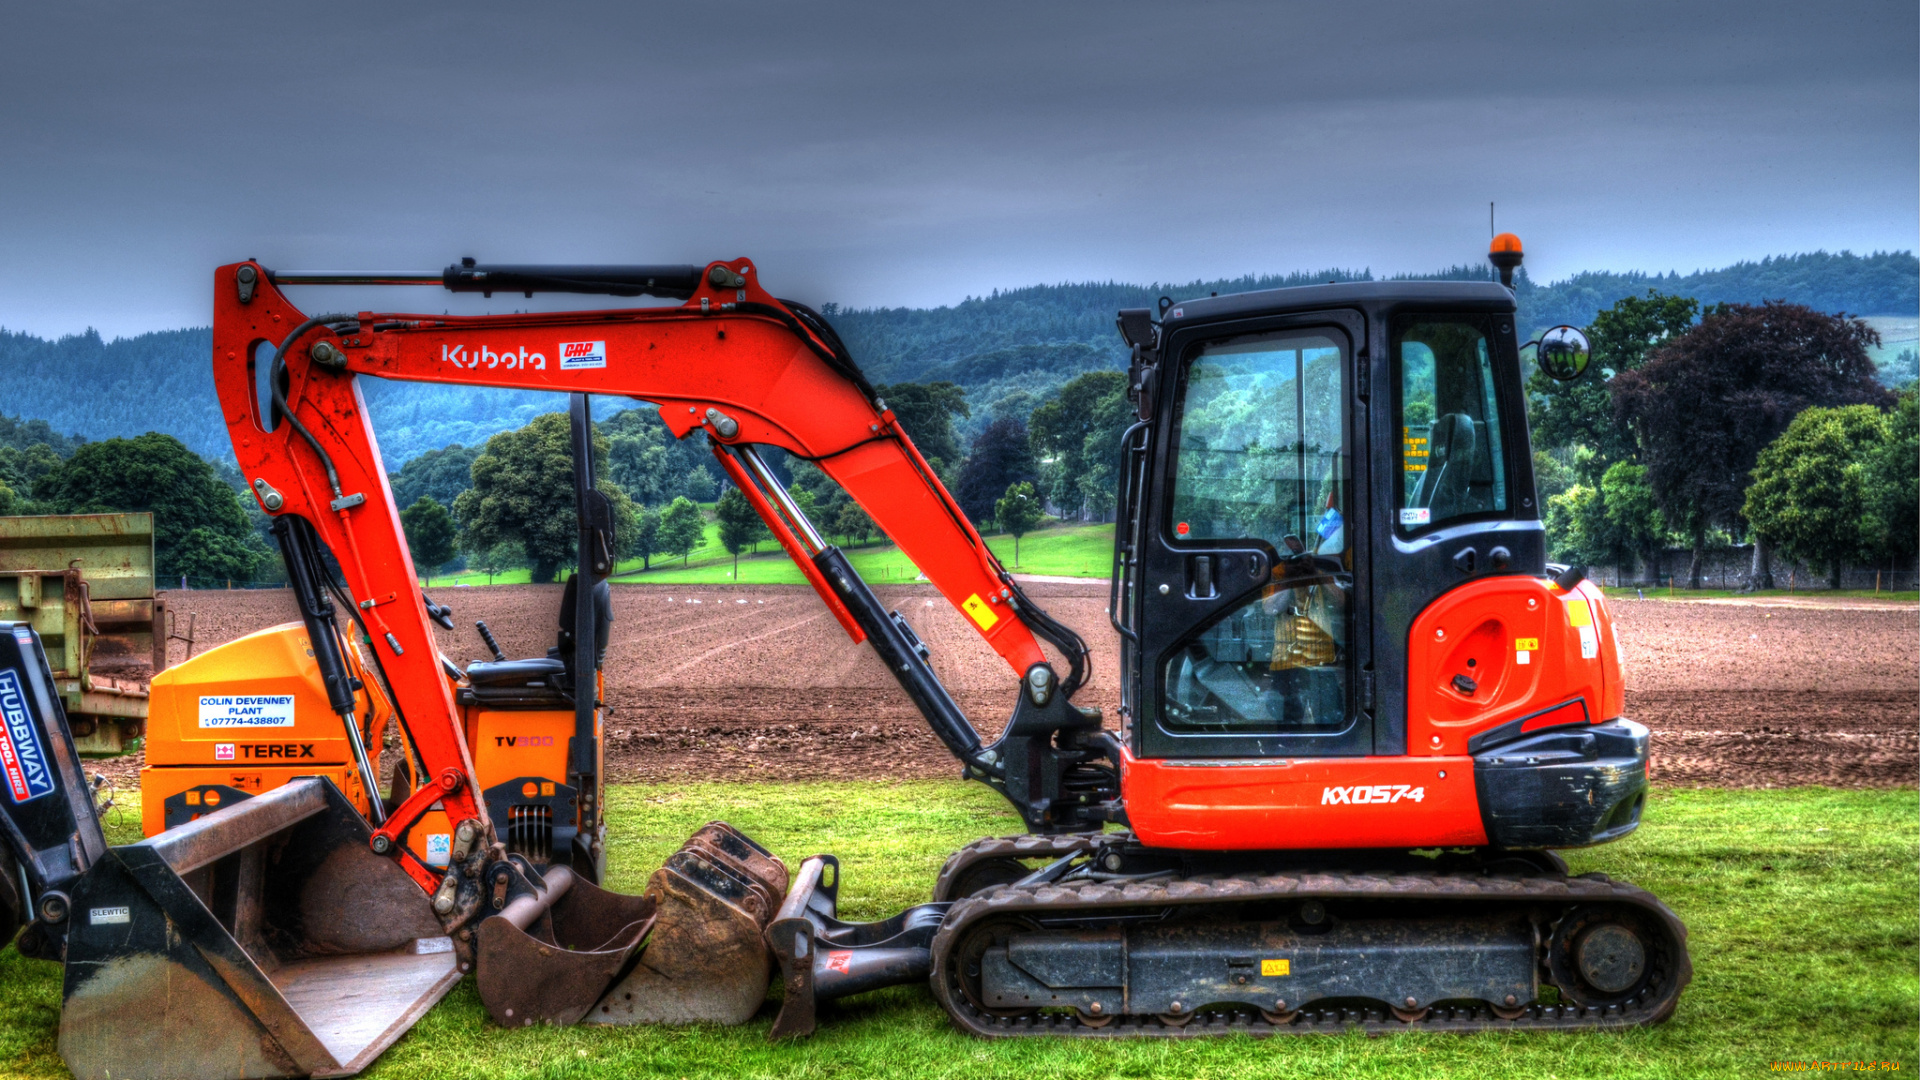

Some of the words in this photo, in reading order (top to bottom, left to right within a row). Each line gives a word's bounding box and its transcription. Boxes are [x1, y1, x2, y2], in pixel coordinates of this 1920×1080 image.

[564, 342, 594, 357] GAP
[442, 344, 546, 370] Kubota
[200, 697, 233, 706] COLIN
[235, 696, 292, 705] DEVENNEY
[228, 707, 263, 715] PLANT
[211, 716, 286, 725] 07774-438807
[0, 677, 48, 788] HUBBWAY
[494, 736, 554, 747] TV900
[240, 744, 315, 758] TEREX
[9, 767, 25, 795] HIRE
[92, 908, 128, 917] SLEWTIC
